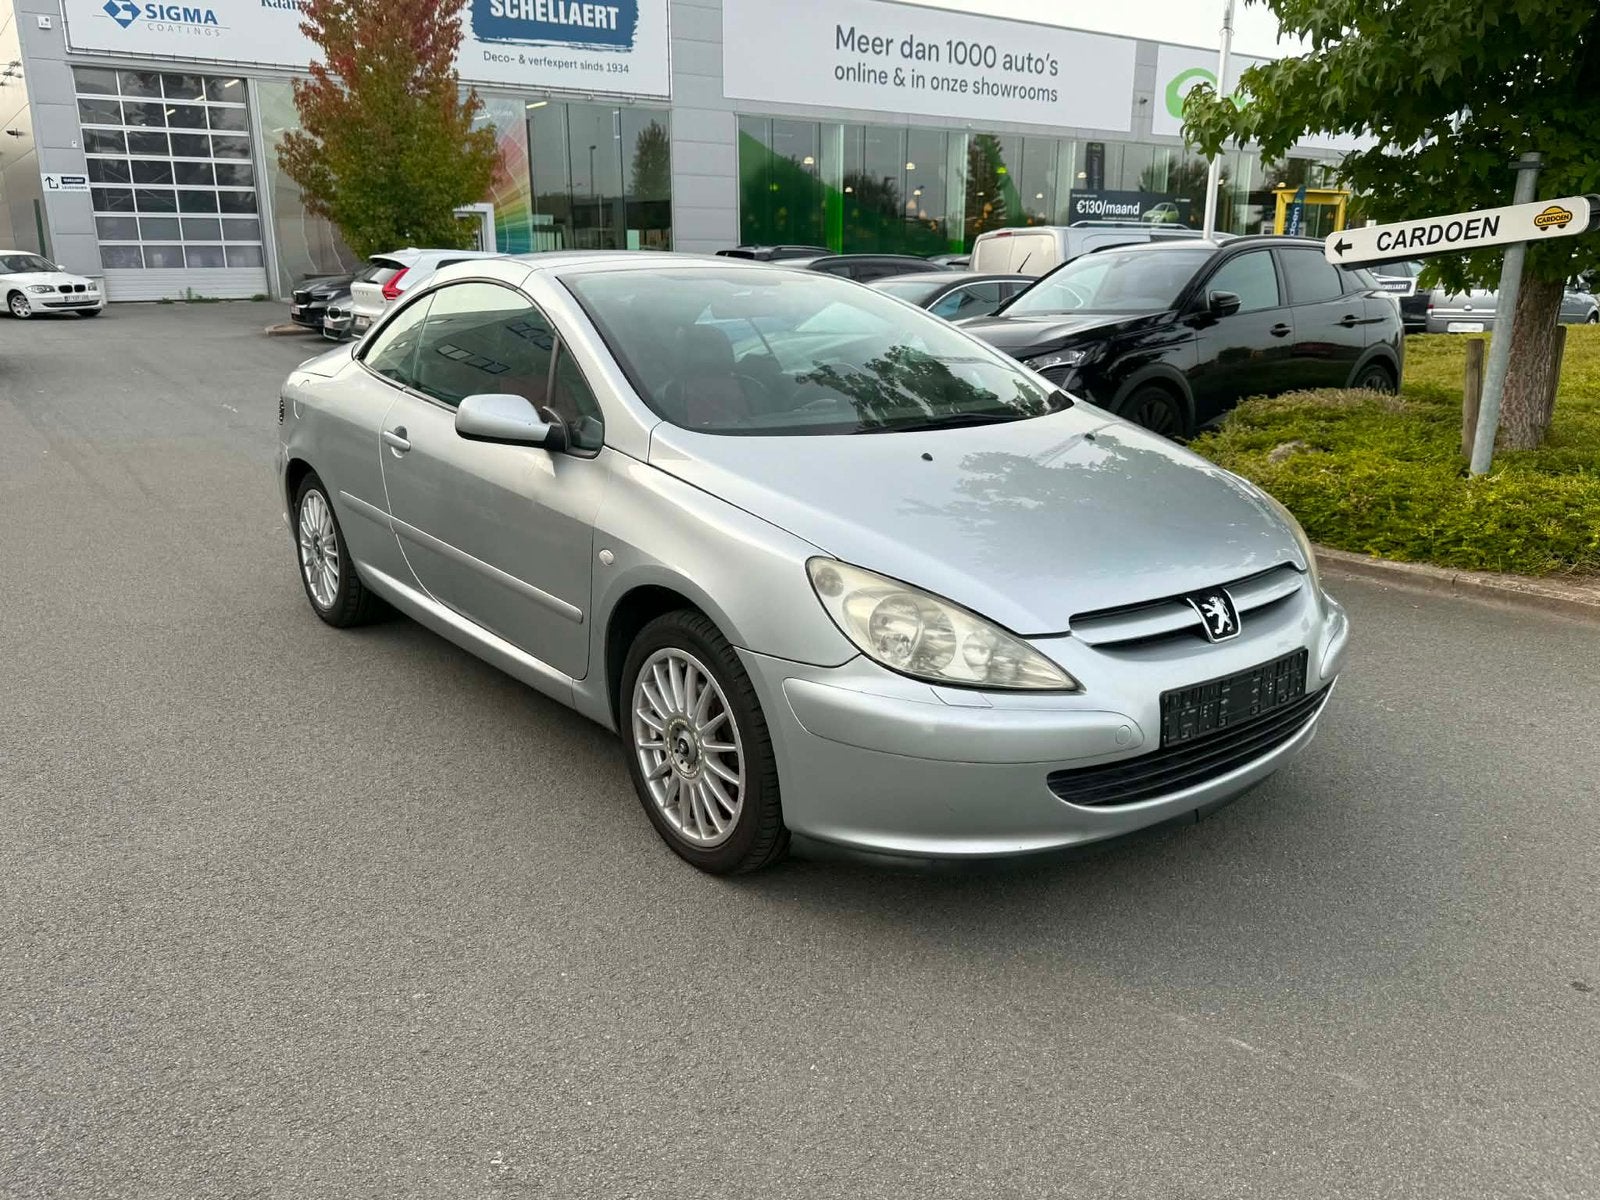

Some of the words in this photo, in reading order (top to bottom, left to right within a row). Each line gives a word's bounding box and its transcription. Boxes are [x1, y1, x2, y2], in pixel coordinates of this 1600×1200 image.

[145, 3, 218, 25] SIGMA
[490, 0, 619, 30] SCHELLAERT
[147, 23, 220, 37] COATINGS
[483, 50, 515, 63] Deco-
[518, 54, 526, 65] &
[528, 56, 577, 70] verfexpert
[579, 60, 604, 72] sinds
[606, 62, 629, 74] 1934
[835, 24, 894, 57] Meer
[900, 34, 940, 62] dan
[946, 39, 997, 69] 1000
[1002, 52, 1059, 77] auto's
[834, 62, 888, 86] online
[893, 66, 906, 88] &
[911, 69, 926, 89] in
[930, 74, 968, 94] onze
[972, 76, 1058, 103] showrooms
[1076, 200, 1140, 216] €130/maand
[1536, 213, 1570, 224] CARDOEN
[1376, 215, 1500, 251] CARDOEN
